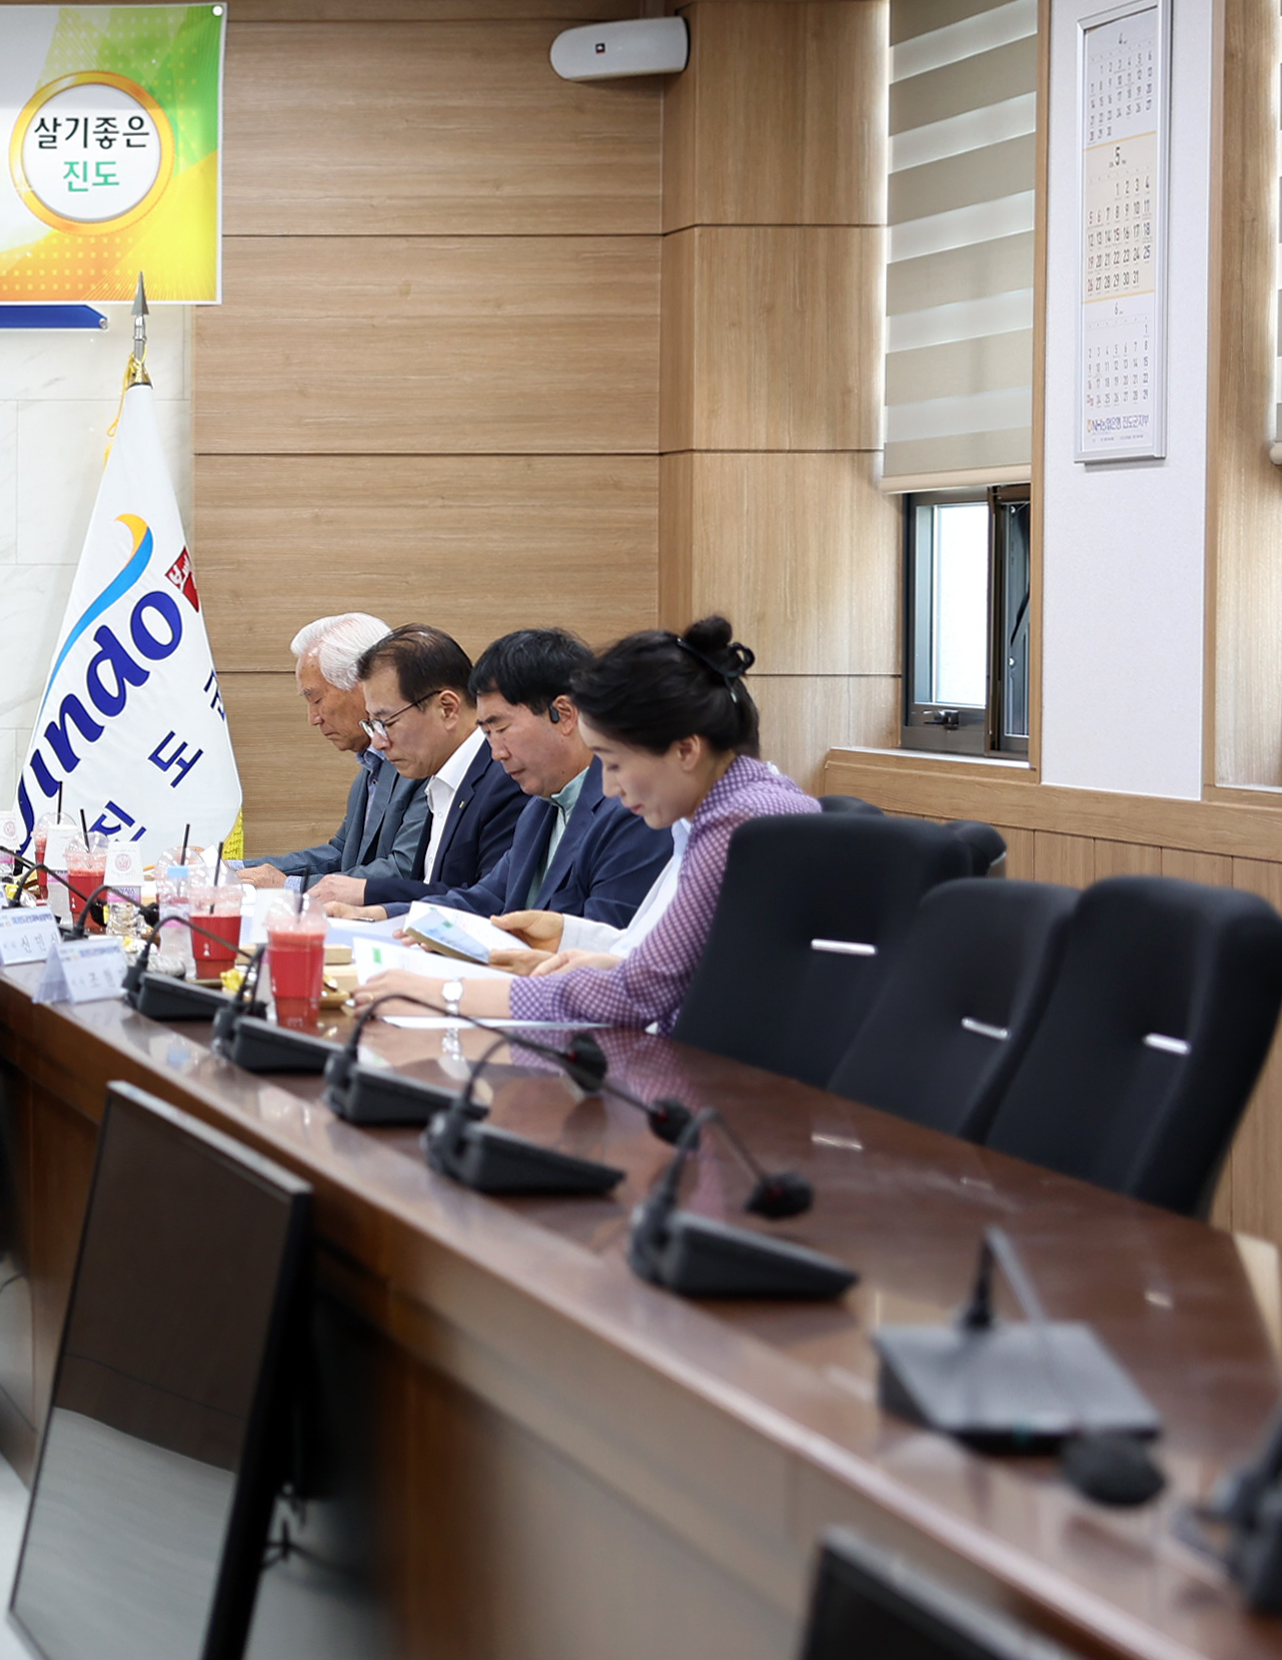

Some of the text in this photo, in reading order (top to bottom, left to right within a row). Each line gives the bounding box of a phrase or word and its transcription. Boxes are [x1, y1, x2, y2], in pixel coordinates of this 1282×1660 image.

[33, 116, 151, 151] 살기좋은
[1115, 146, 1120, 165] 5
[62, 160, 121, 192] 진도
